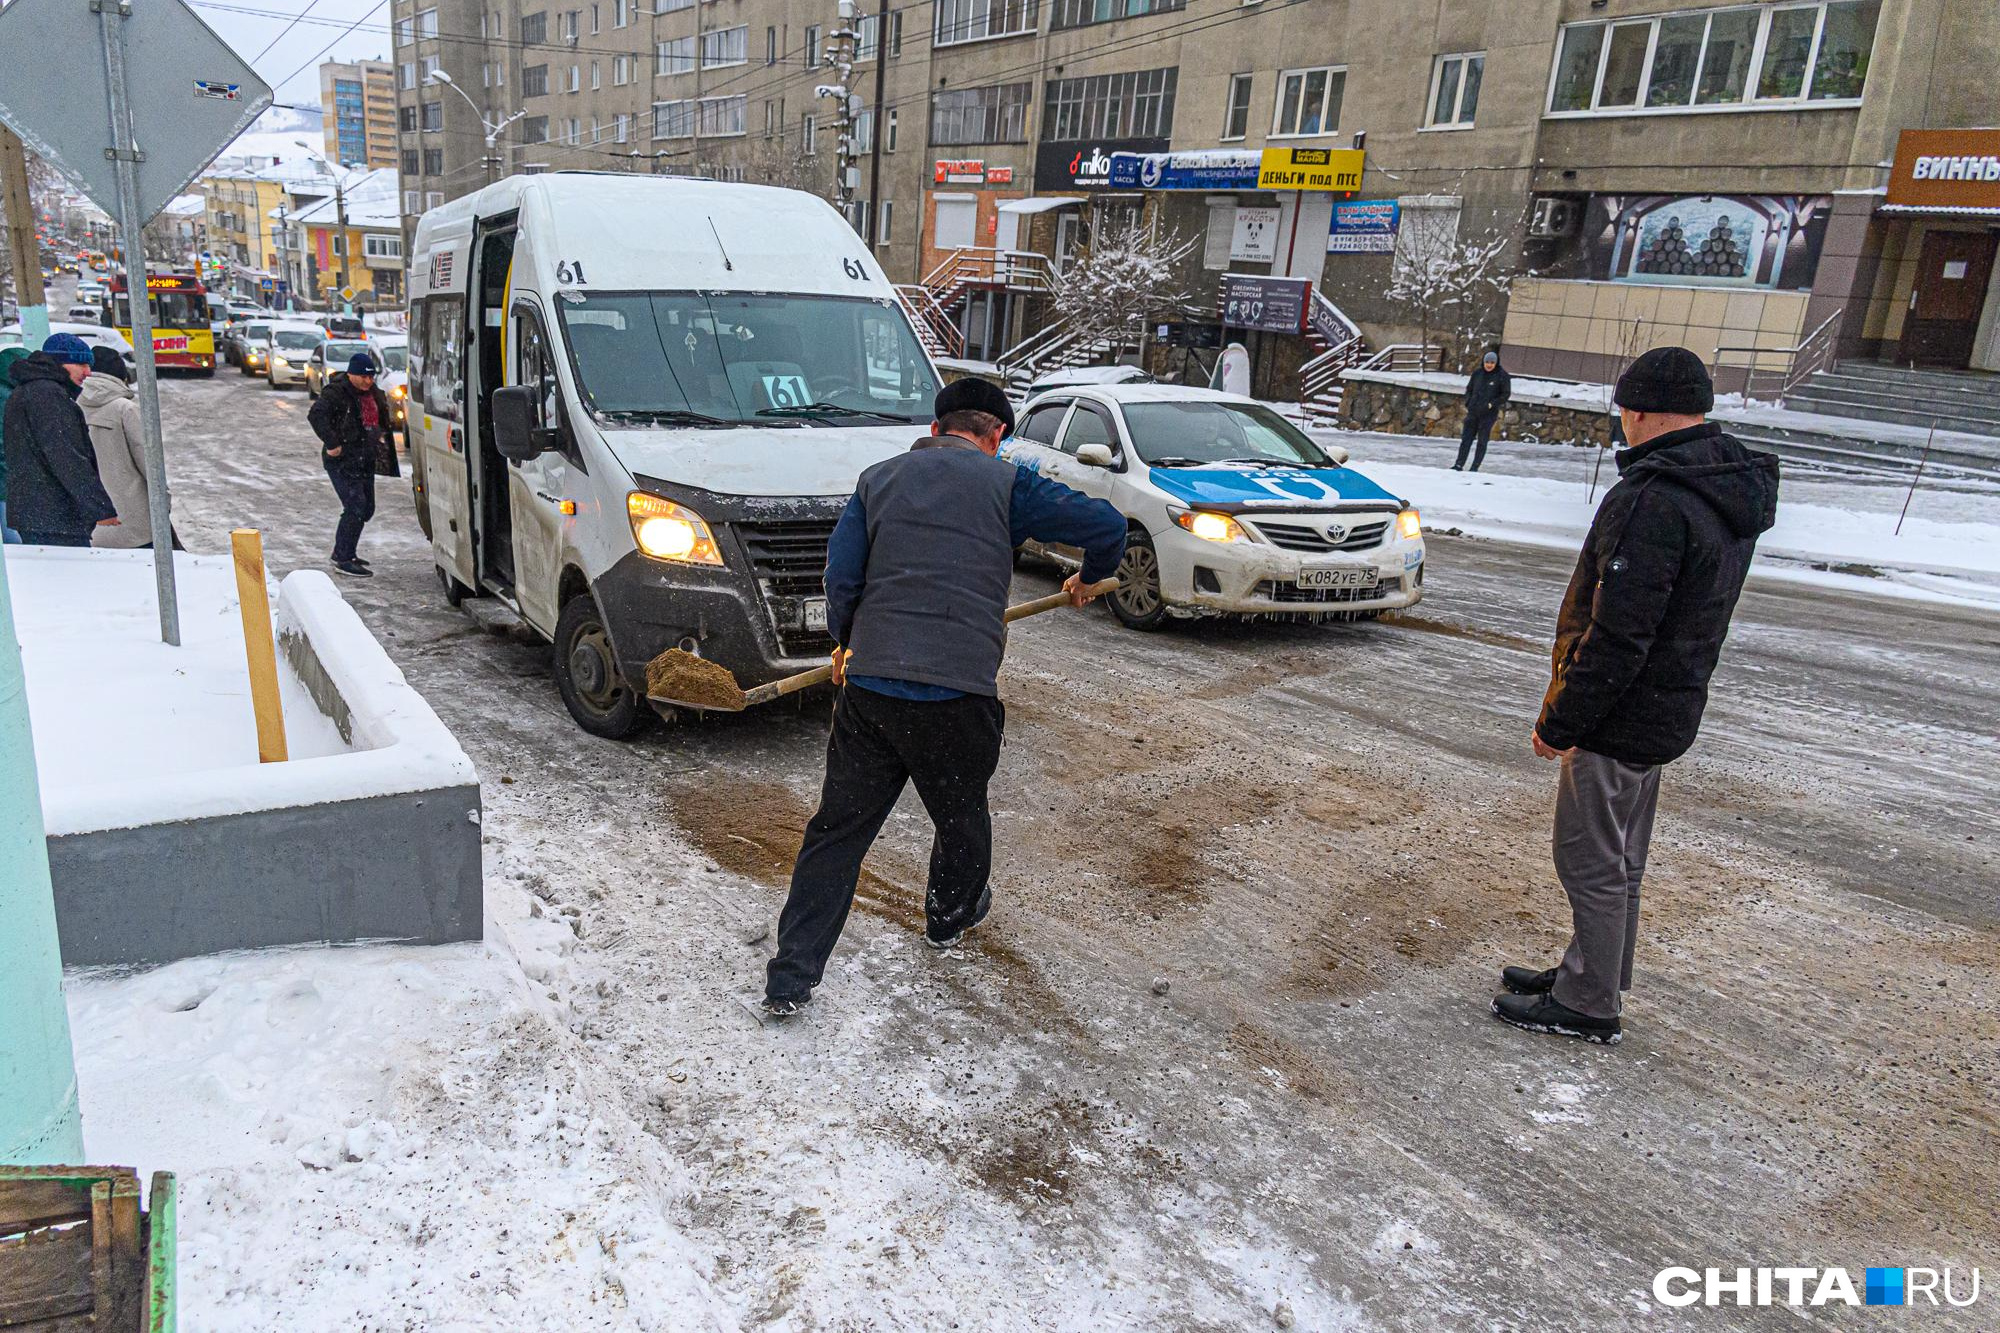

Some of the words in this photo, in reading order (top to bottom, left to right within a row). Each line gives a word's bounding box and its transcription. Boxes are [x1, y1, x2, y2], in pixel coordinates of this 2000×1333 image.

[1081, 147, 1110, 175] miko
[1114, 176, 1135, 184] КАССЫ
[1262, 171, 1306, 185] ДЕНЬГИ
[1336, 173, 1358, 186] ПТС
[556, 260, 587, 285] 61
[843, 257, 871, 281] 61
[1319, 311, 1346, 341] СКУПКА
[772, 376, 807, 407] 61
[1361, 569, 1373, 580] 75
